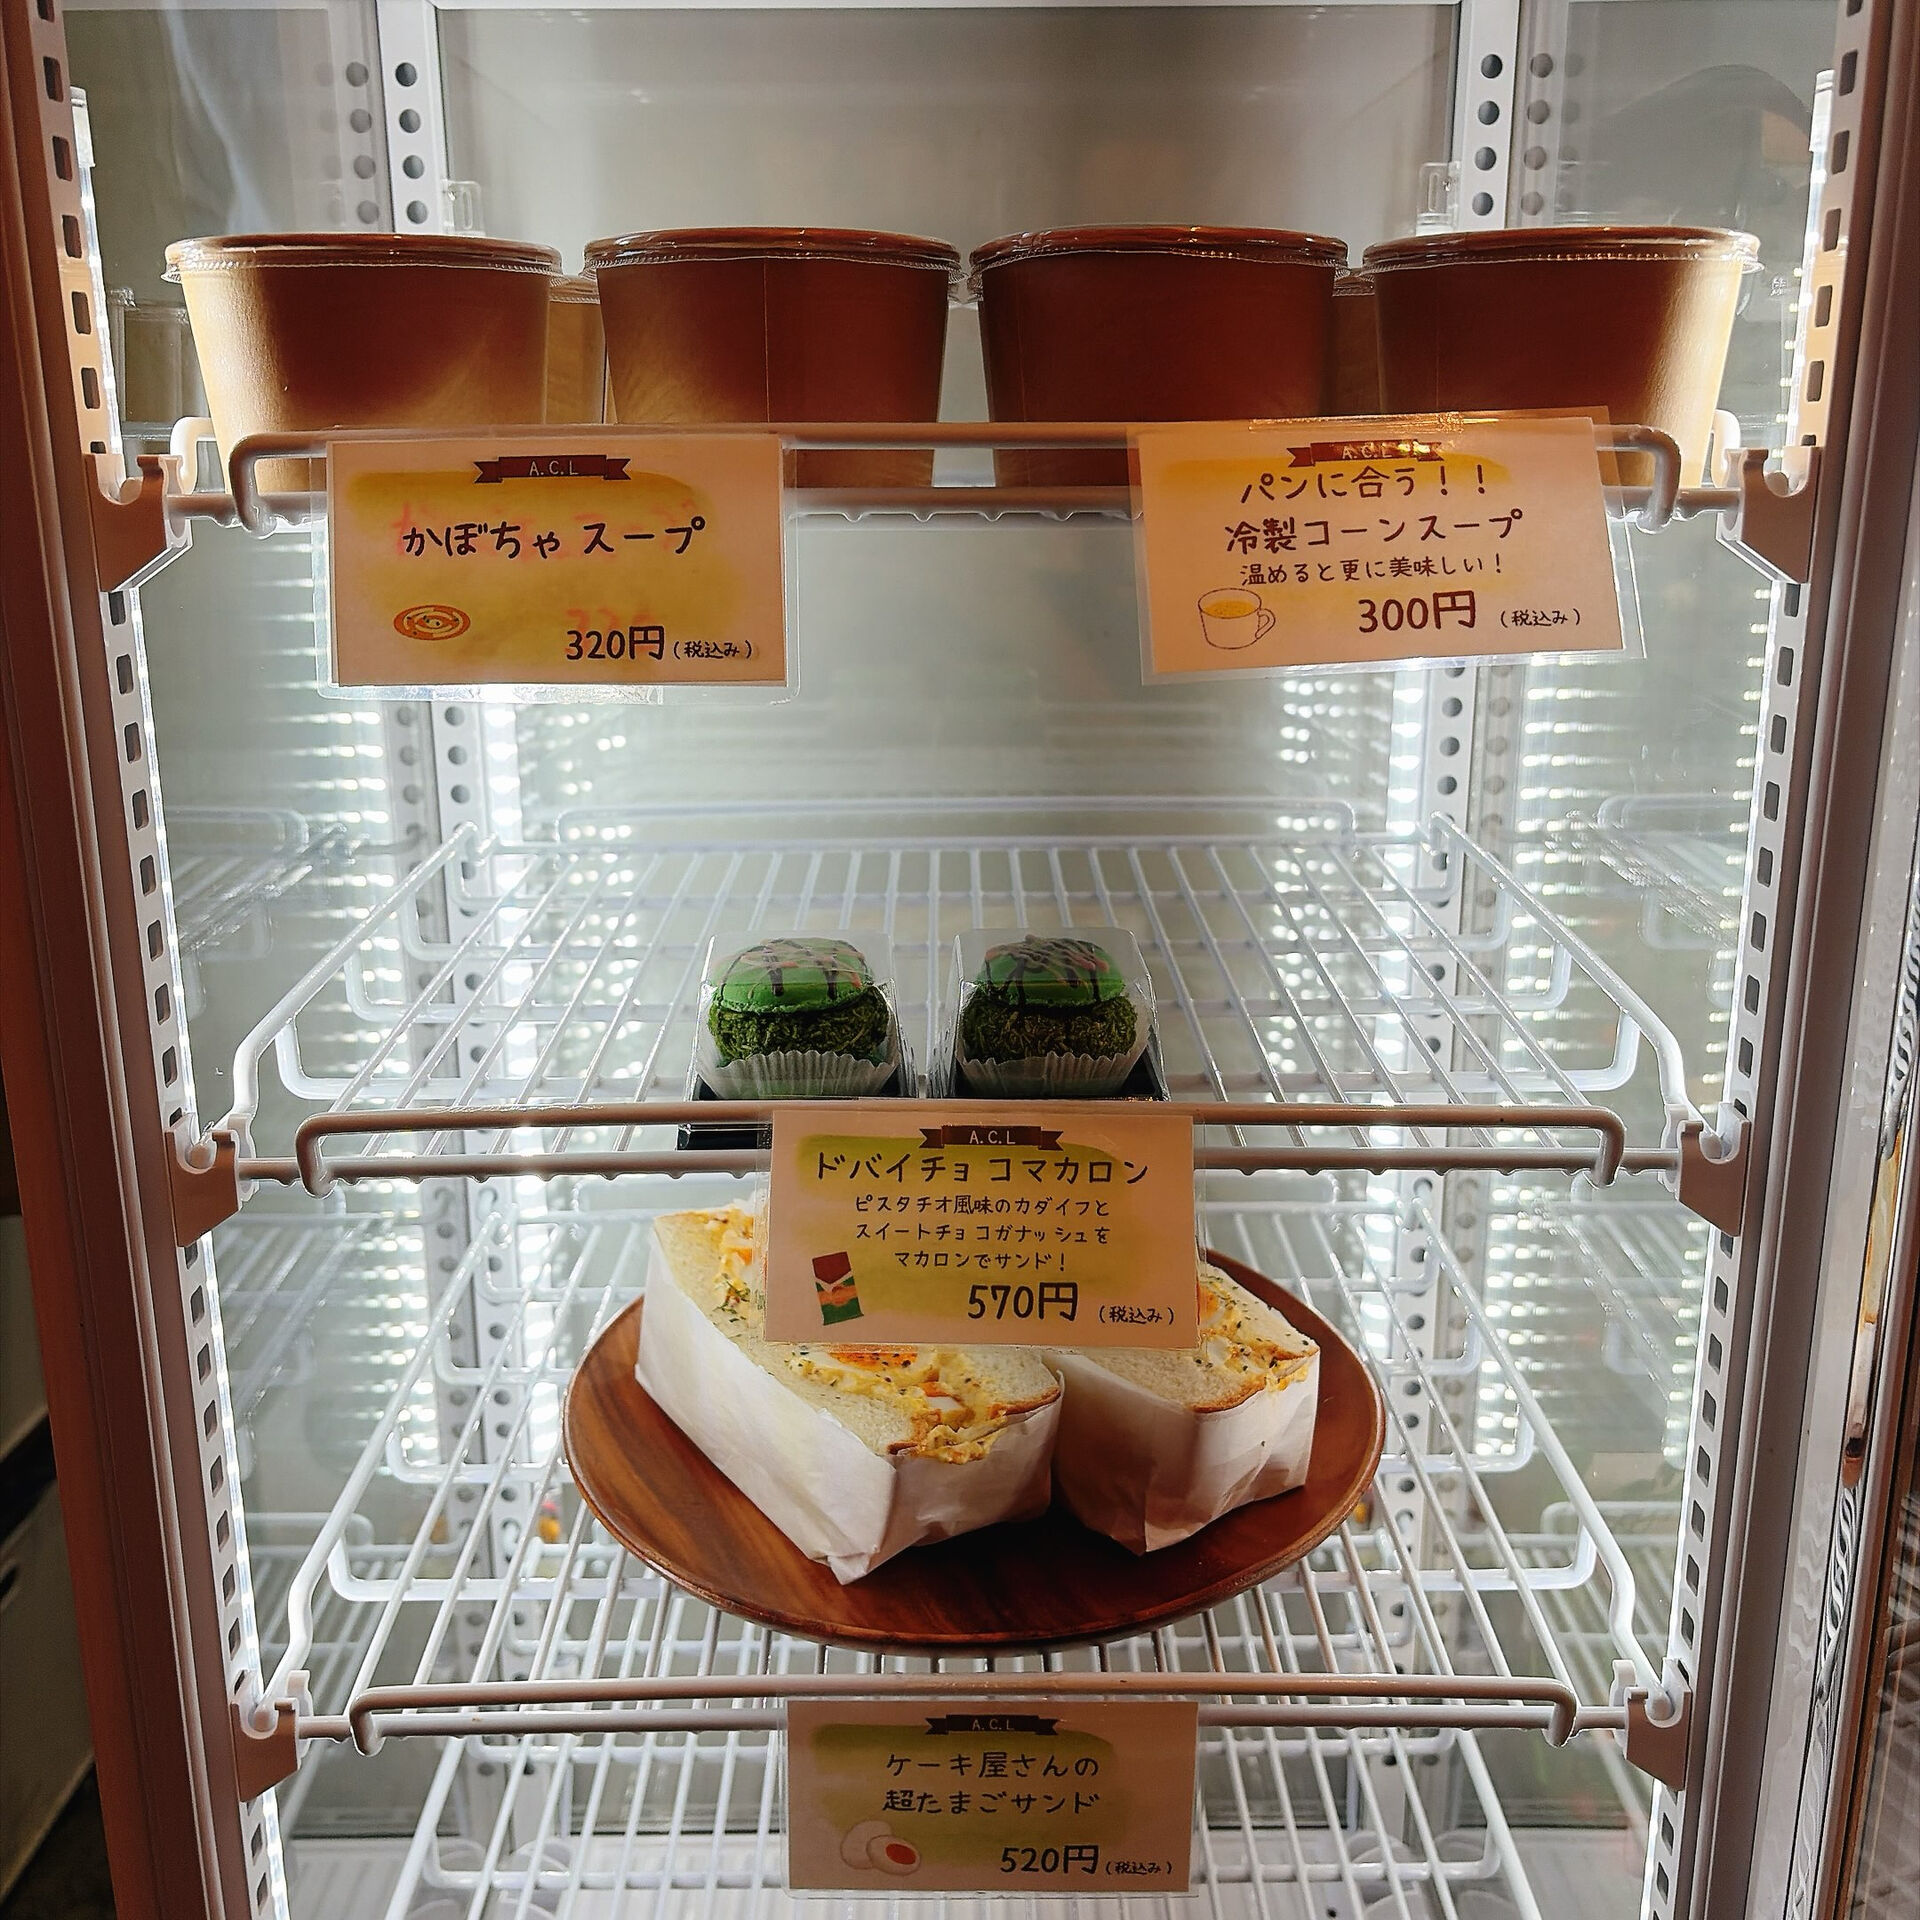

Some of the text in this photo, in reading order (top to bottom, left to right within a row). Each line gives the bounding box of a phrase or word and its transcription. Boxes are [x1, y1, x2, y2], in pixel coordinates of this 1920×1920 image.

[529, 459, 580, 477] A.C.L
[1240, 464, 1486, 504] パンに合う！！
[402, 516, 706, 560] かぼちゃスープ
[1225, 508, 1524, 554] 冷製コーンスープ
[1240, 554, 1502, 586] 温めると更に美味しい！
[1358, 589, 1477, 634] 300円
[566, 625, 665, 661] 320円
[968, 1130, 1017, 1146] A.C.L
[818, 1151, 1149, 1185] ドバイチョコマカロン
[855, 1194, 1110, 1217] ピスタチオ風味のカダイフと
[856, 1222, 1111, 1245] スイートチョコガナッシュを
[894, 1250, 1066, 1272] マカロンでサンド！
[967, 1281, 1079, 1321] 570円
[972, 1718, 1014, 1732] A.C.L
[886, 1751, 1099, 1779] ケーキ屋さんの
[882, 1789, 1100, 1815] 超たまごサンド
[999, 1844, 1099, 1875] 520円
